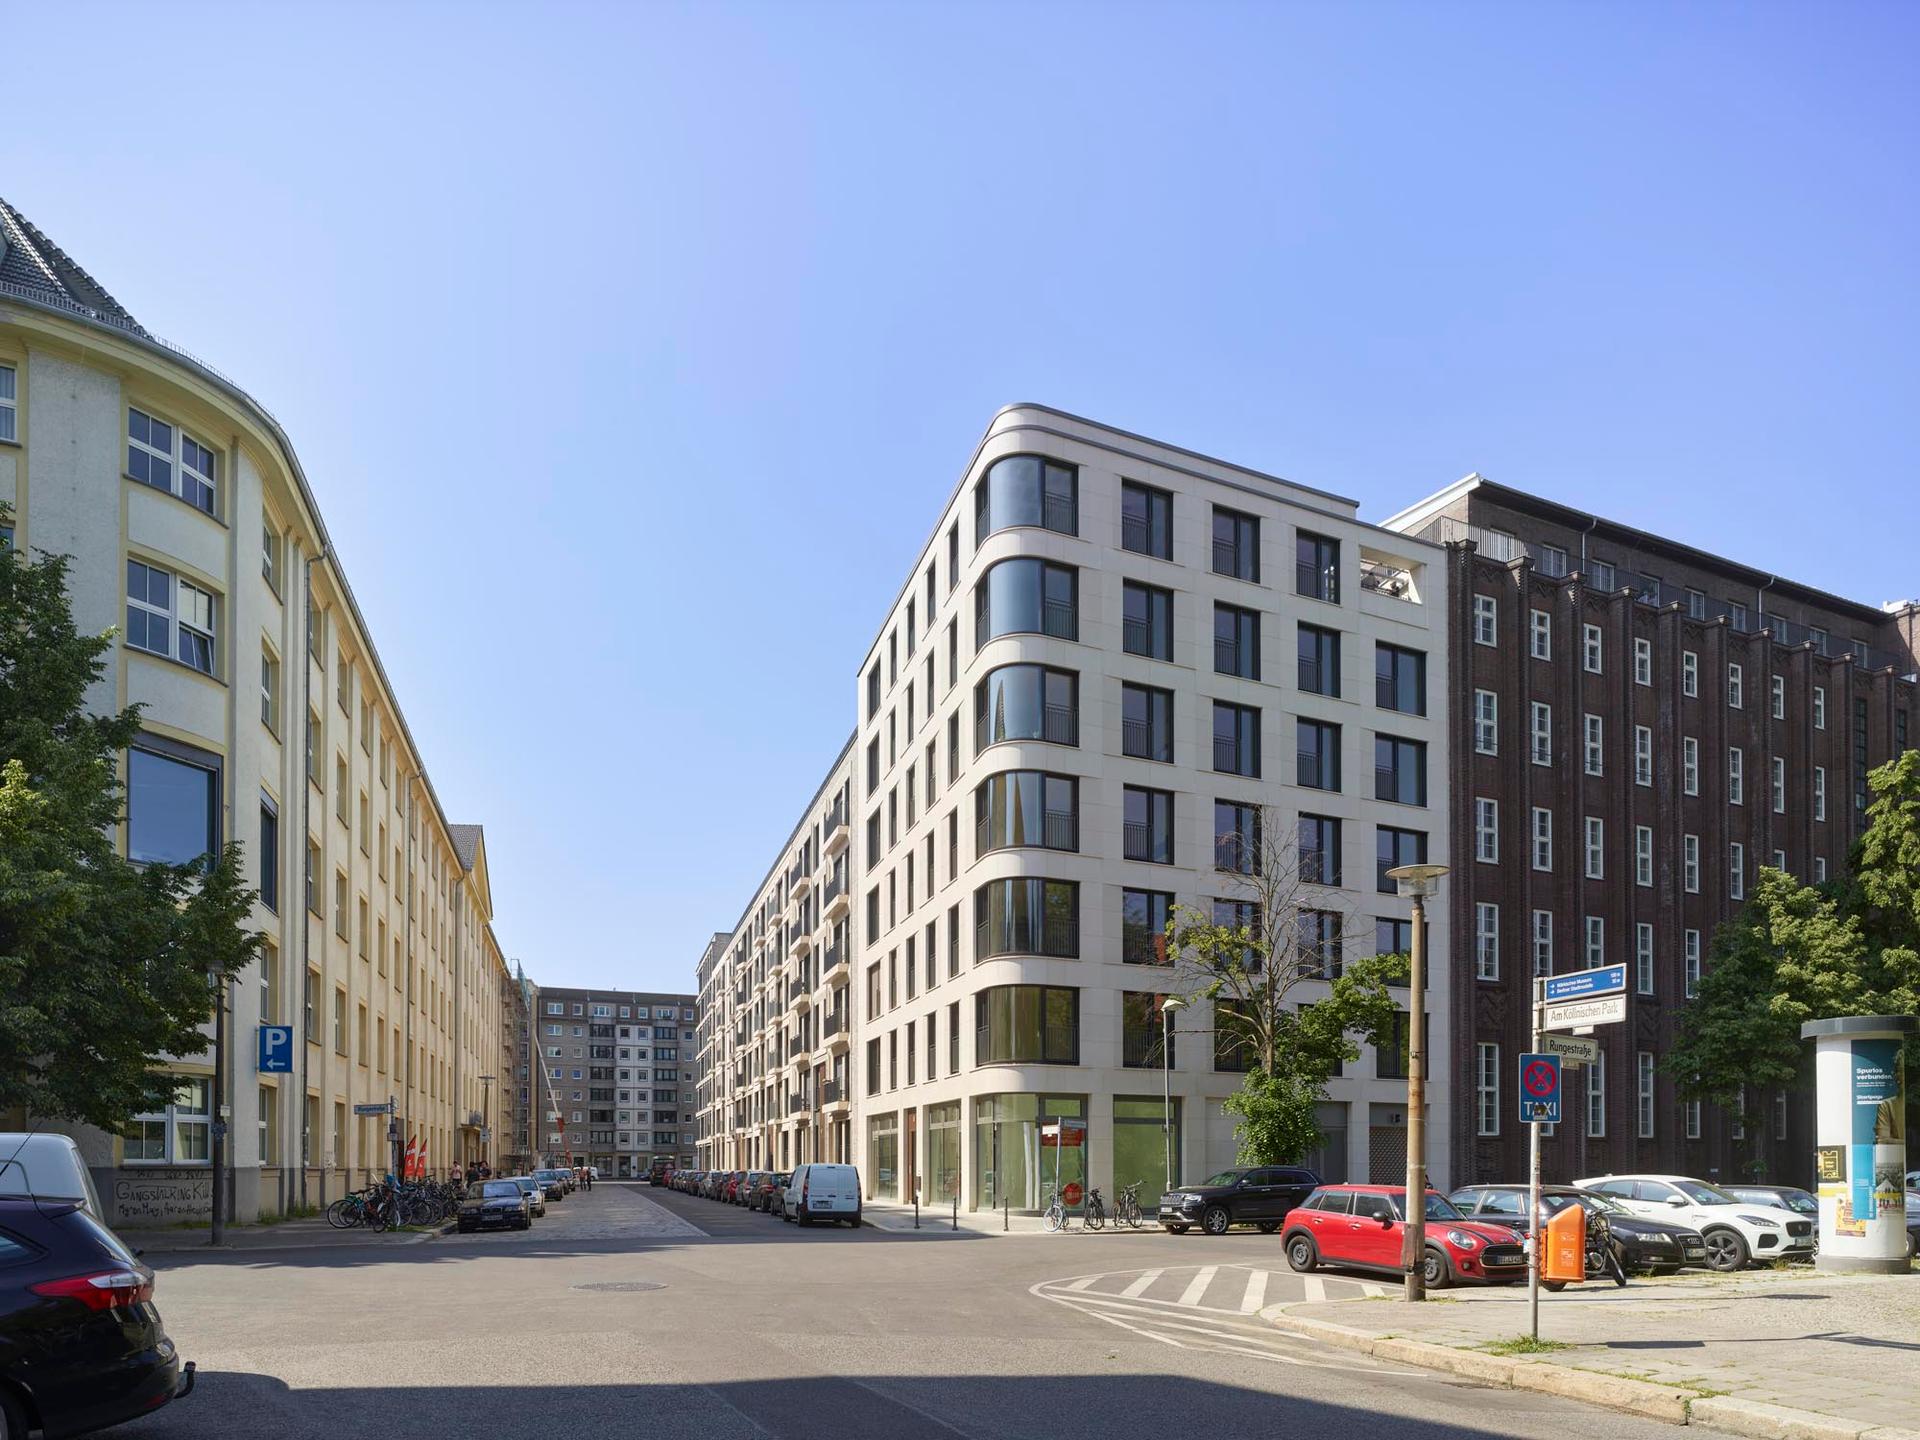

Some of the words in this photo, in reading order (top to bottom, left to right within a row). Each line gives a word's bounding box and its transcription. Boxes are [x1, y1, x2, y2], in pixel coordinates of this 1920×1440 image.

[1551, 1009, 1562, 1021] Am
[1563, 1004, 1600, 1020] Köllnischen
[1602, 1000, 1618, 1015] Park
[266, 1028, 287, 1055] P
[1550, 1040, 1591, 1058] Rungestraße
